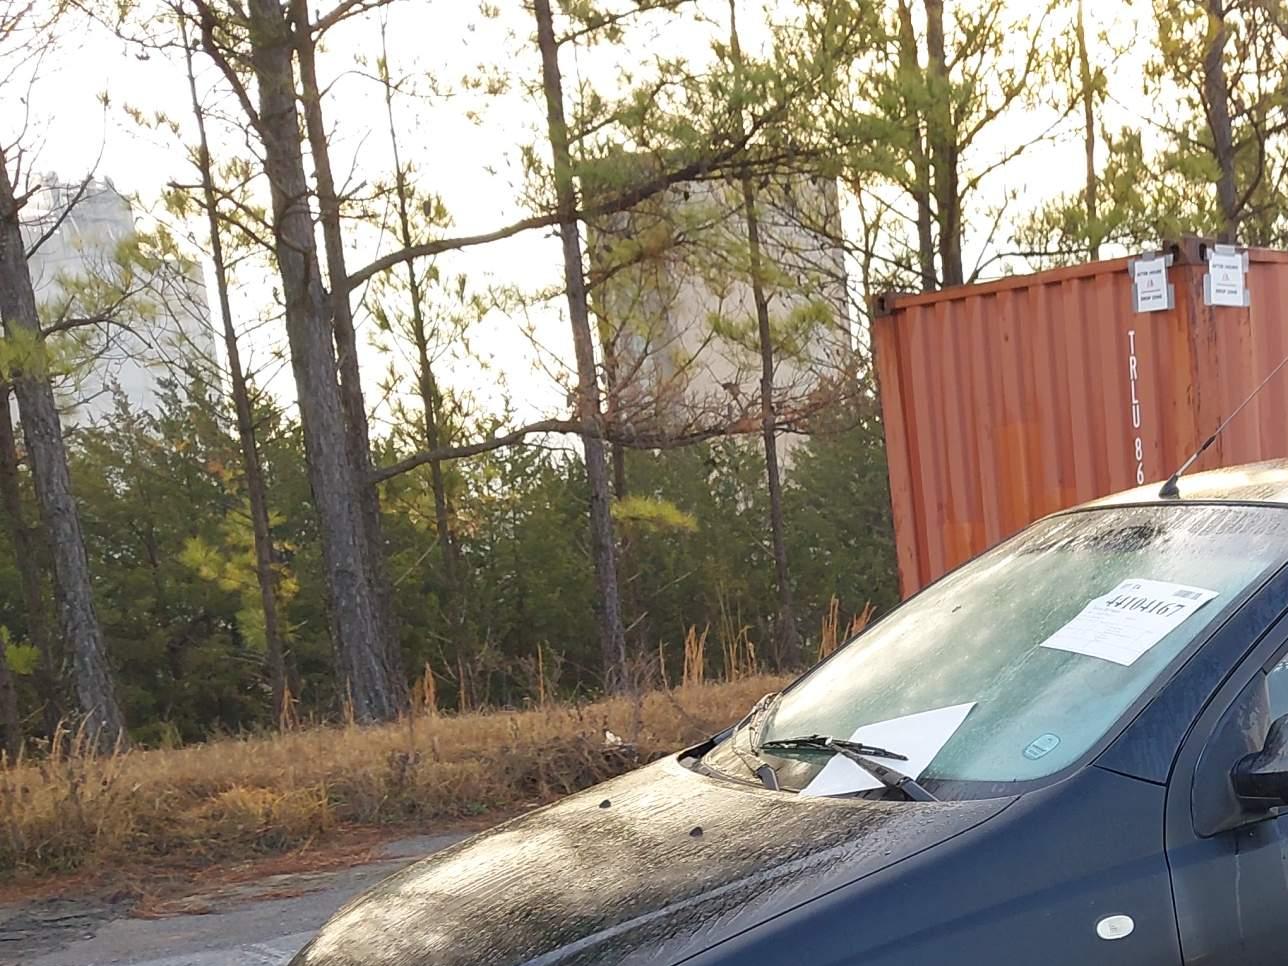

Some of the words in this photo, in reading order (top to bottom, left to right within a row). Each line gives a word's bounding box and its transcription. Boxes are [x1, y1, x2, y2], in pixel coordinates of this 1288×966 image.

[1128, 330, 1142, 429] TRLU
[1134, 437, 1145, 485] 86
[1106, 595, 1186, 618] 44104167
